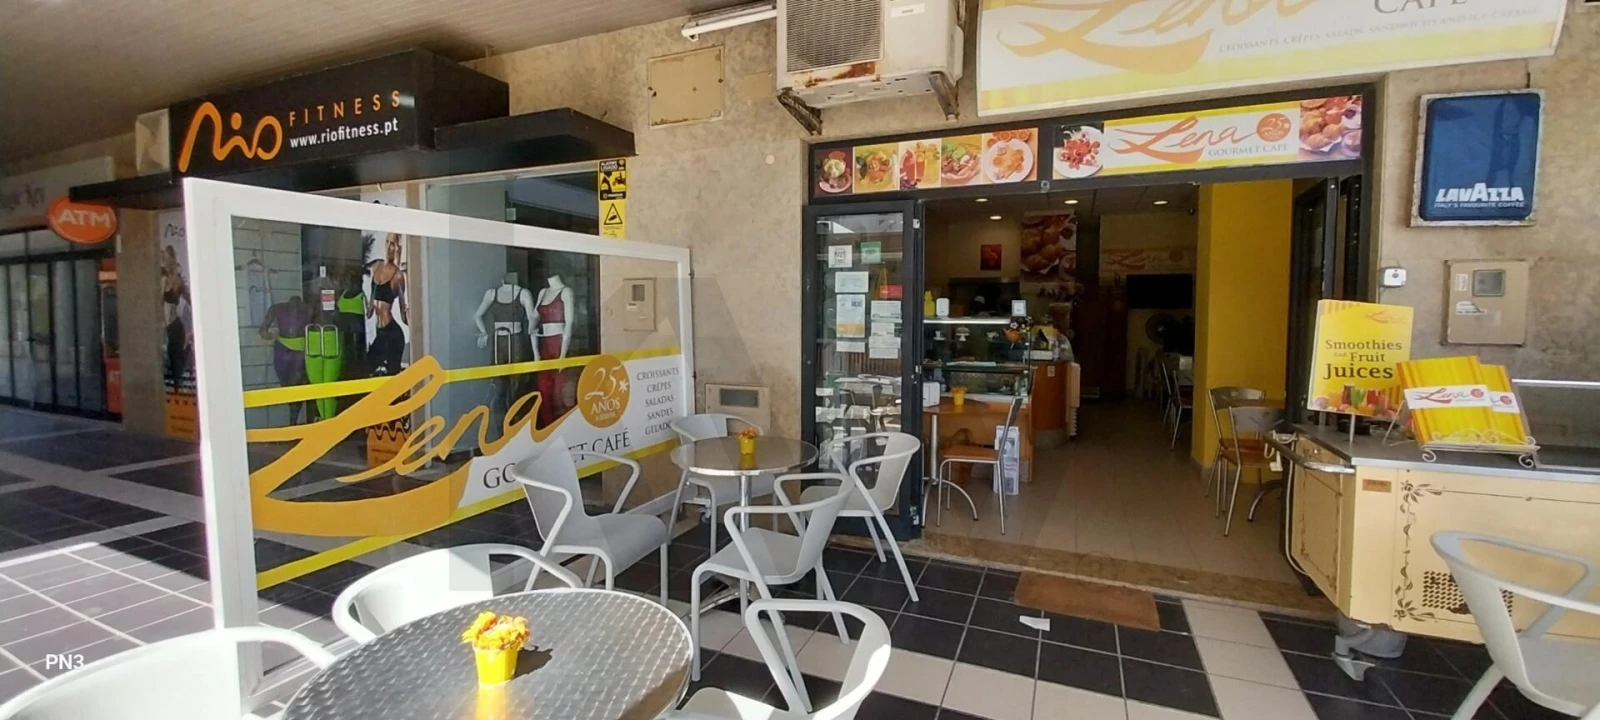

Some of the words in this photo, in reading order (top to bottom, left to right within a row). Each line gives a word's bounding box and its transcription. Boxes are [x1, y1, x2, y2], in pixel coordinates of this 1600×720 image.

[290, 89, 401, 127] FITNESS
[290, 117, 399, 148] www.riofitness.pt
[1108, 116, 1257, 164] Lena
[1208, 146, 1260, 157] GOURMET
[1435, 182, 1525, 202] LAVAZZA
[57, 209, 110, 228] ATM
[1325, 339, 1403, 350] Smoothies
[1349, 352, 1386, 362] Fruit
[636, 367, 679, 381] CROISSANTS
[1323, 363, 1393, 380] Juices
[590, 398, 621, 415] ANOS
[644, 394, 674, 407] SALADAS
[646, 407, 674, 421] SANDES
[245, 355, 578, 537] Lena
[584, 362, 623, 400] 25
[592, 427, 630, 455] CAFÉ
